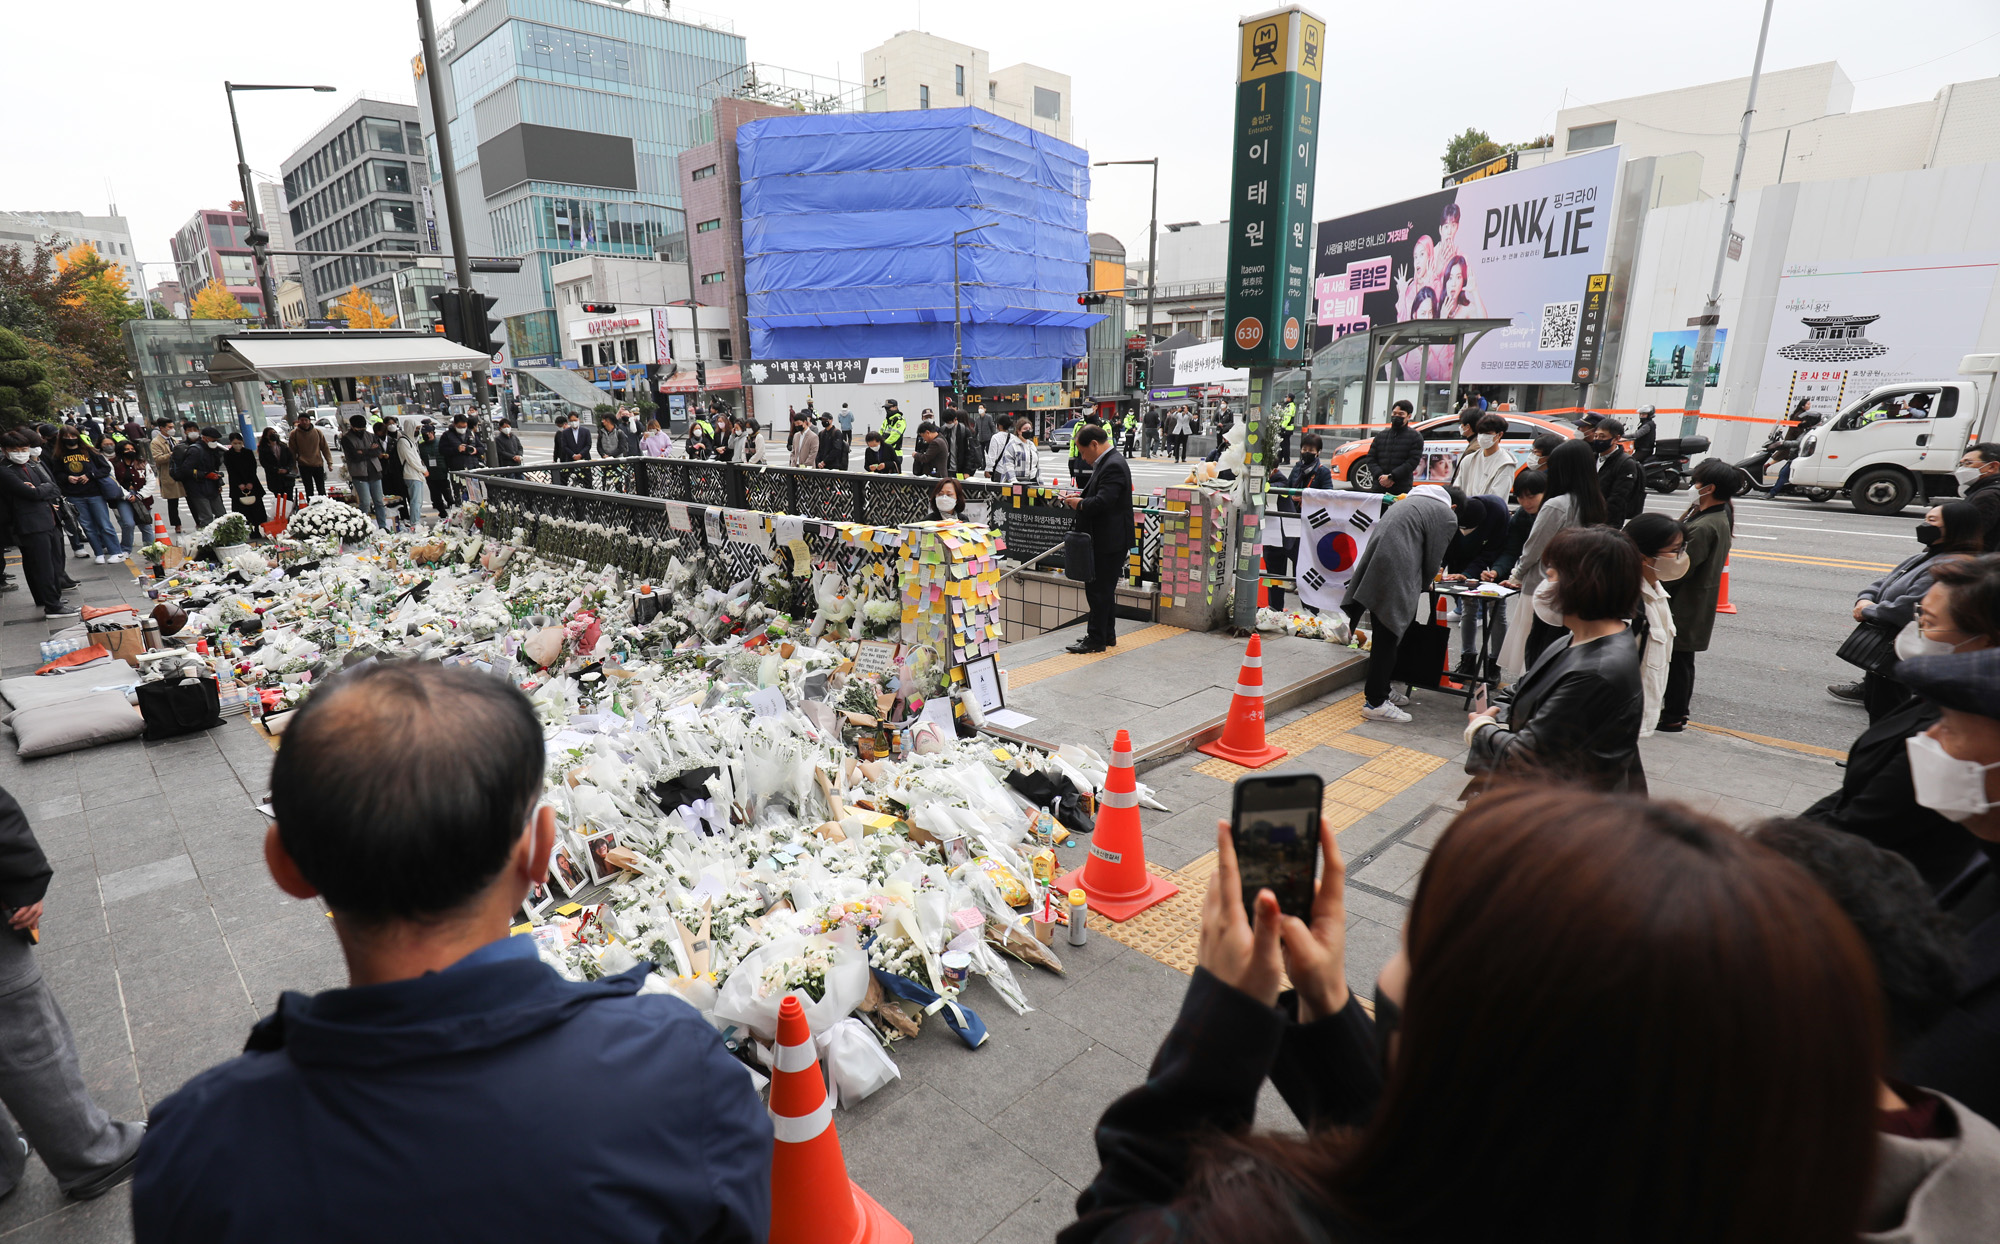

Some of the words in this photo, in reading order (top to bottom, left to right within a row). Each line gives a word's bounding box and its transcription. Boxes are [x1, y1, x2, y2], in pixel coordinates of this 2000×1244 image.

[1257, 82, 1266, 112] 1
[1305, 83, 1311, 112] 1
[1251, 114, 1271, 126] 출입구
[1248, 125, 1273, 135] Entrance
[1245, 139, 1268, 247] 이태원
[1293, 142, 1309, 248] 이태원
[1554, 186, 1598, 209] 핑크라이
[1483, 197, 1549, 251] PINK
[1543, 206, 1595, 259] LIE
[1344, 238, 1357, 252] 위한
[1357, 237, 1365, 250] 단
[1387, 228, 1409, 243] 거짓말
[1241, 265, 1265, 275] Itaewon
[1289, 264, 1303, 274] Itaewon
[1349, 265, 1387, 291] 클럽은
[1591, 293, 1599, 303] 4
[1323, 296, 1358, 319] 오늘이
[656, 310, 666, 358] TRANS
[1238, 327, 1260, 340] 630
[1285, 328, 1298, 340] 630
[1584, 311, 1597, 345] 이태원
[451, 361, 472, 369] 용산구
[771, 360, 799, 373] 이태원
[802, 361, 821, 372] 참사
[825, 360, 862, 371] 희생자의
[787, 372, 816, 384] 명복을
[819, 371, 848, 382] 빕니다
[137, 469, 146, 479] K
